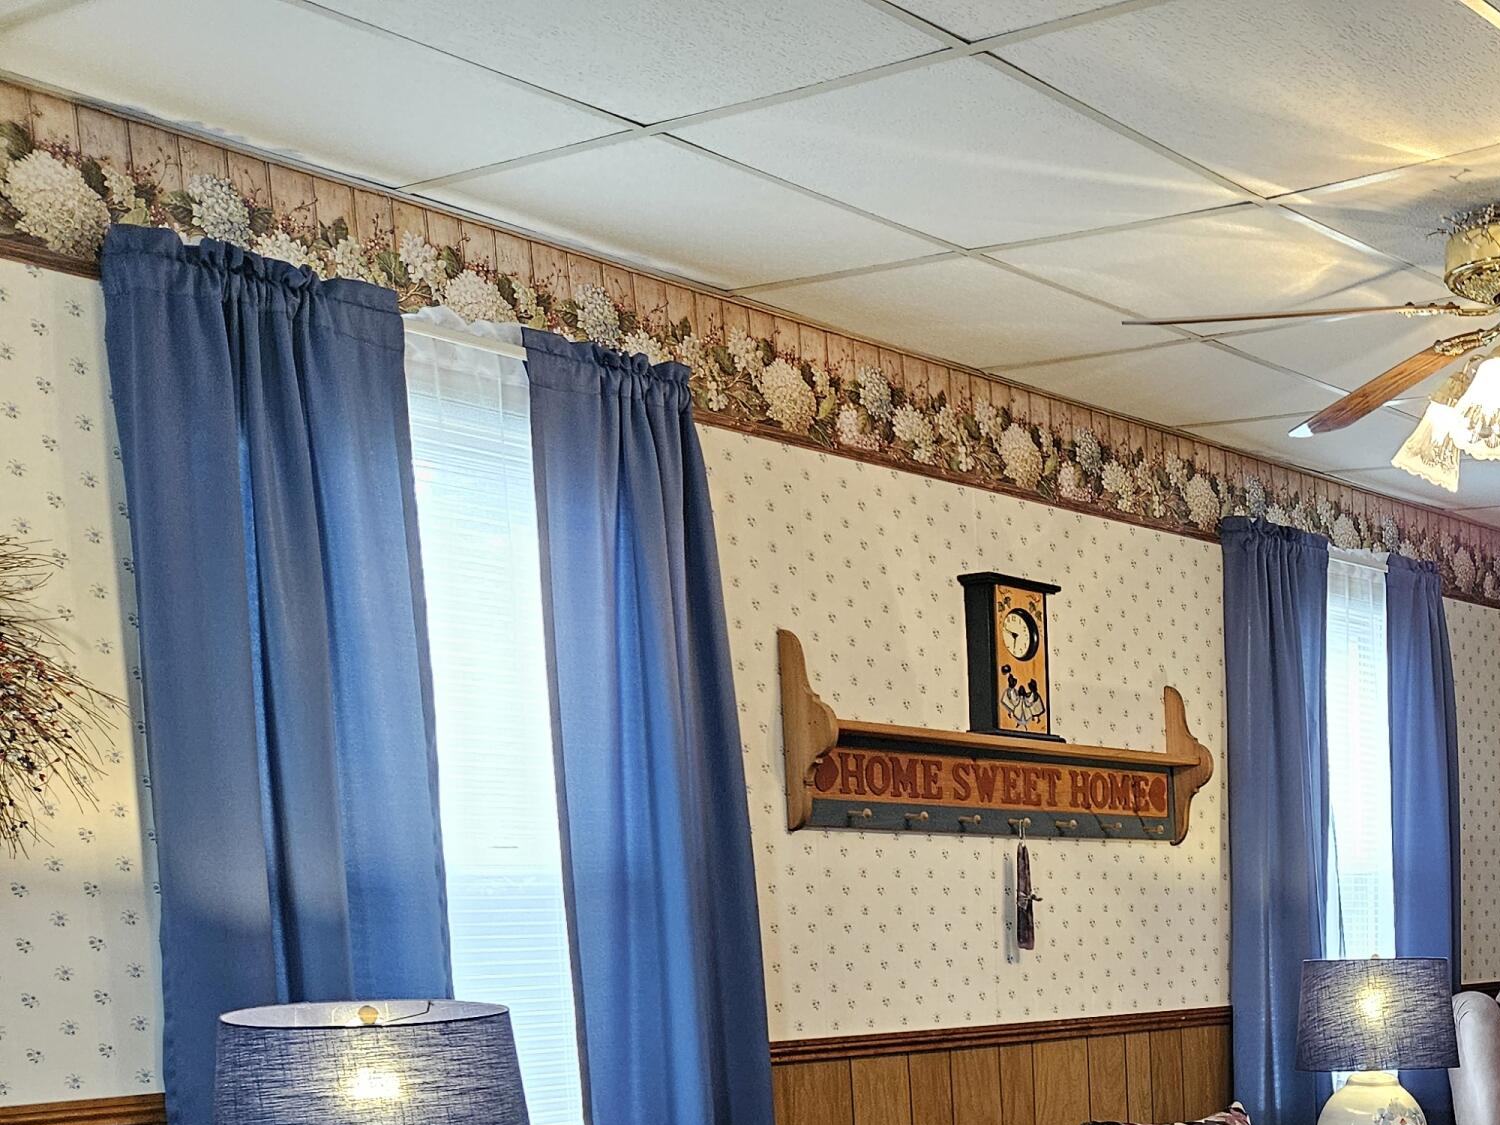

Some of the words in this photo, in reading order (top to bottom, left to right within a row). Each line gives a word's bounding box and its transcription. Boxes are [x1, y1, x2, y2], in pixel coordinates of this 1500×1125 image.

[838, 752, 943, 800] HOME
[952, 762, 1061, 808] SWEET
[1068, 770, 1150, 812] HOME
